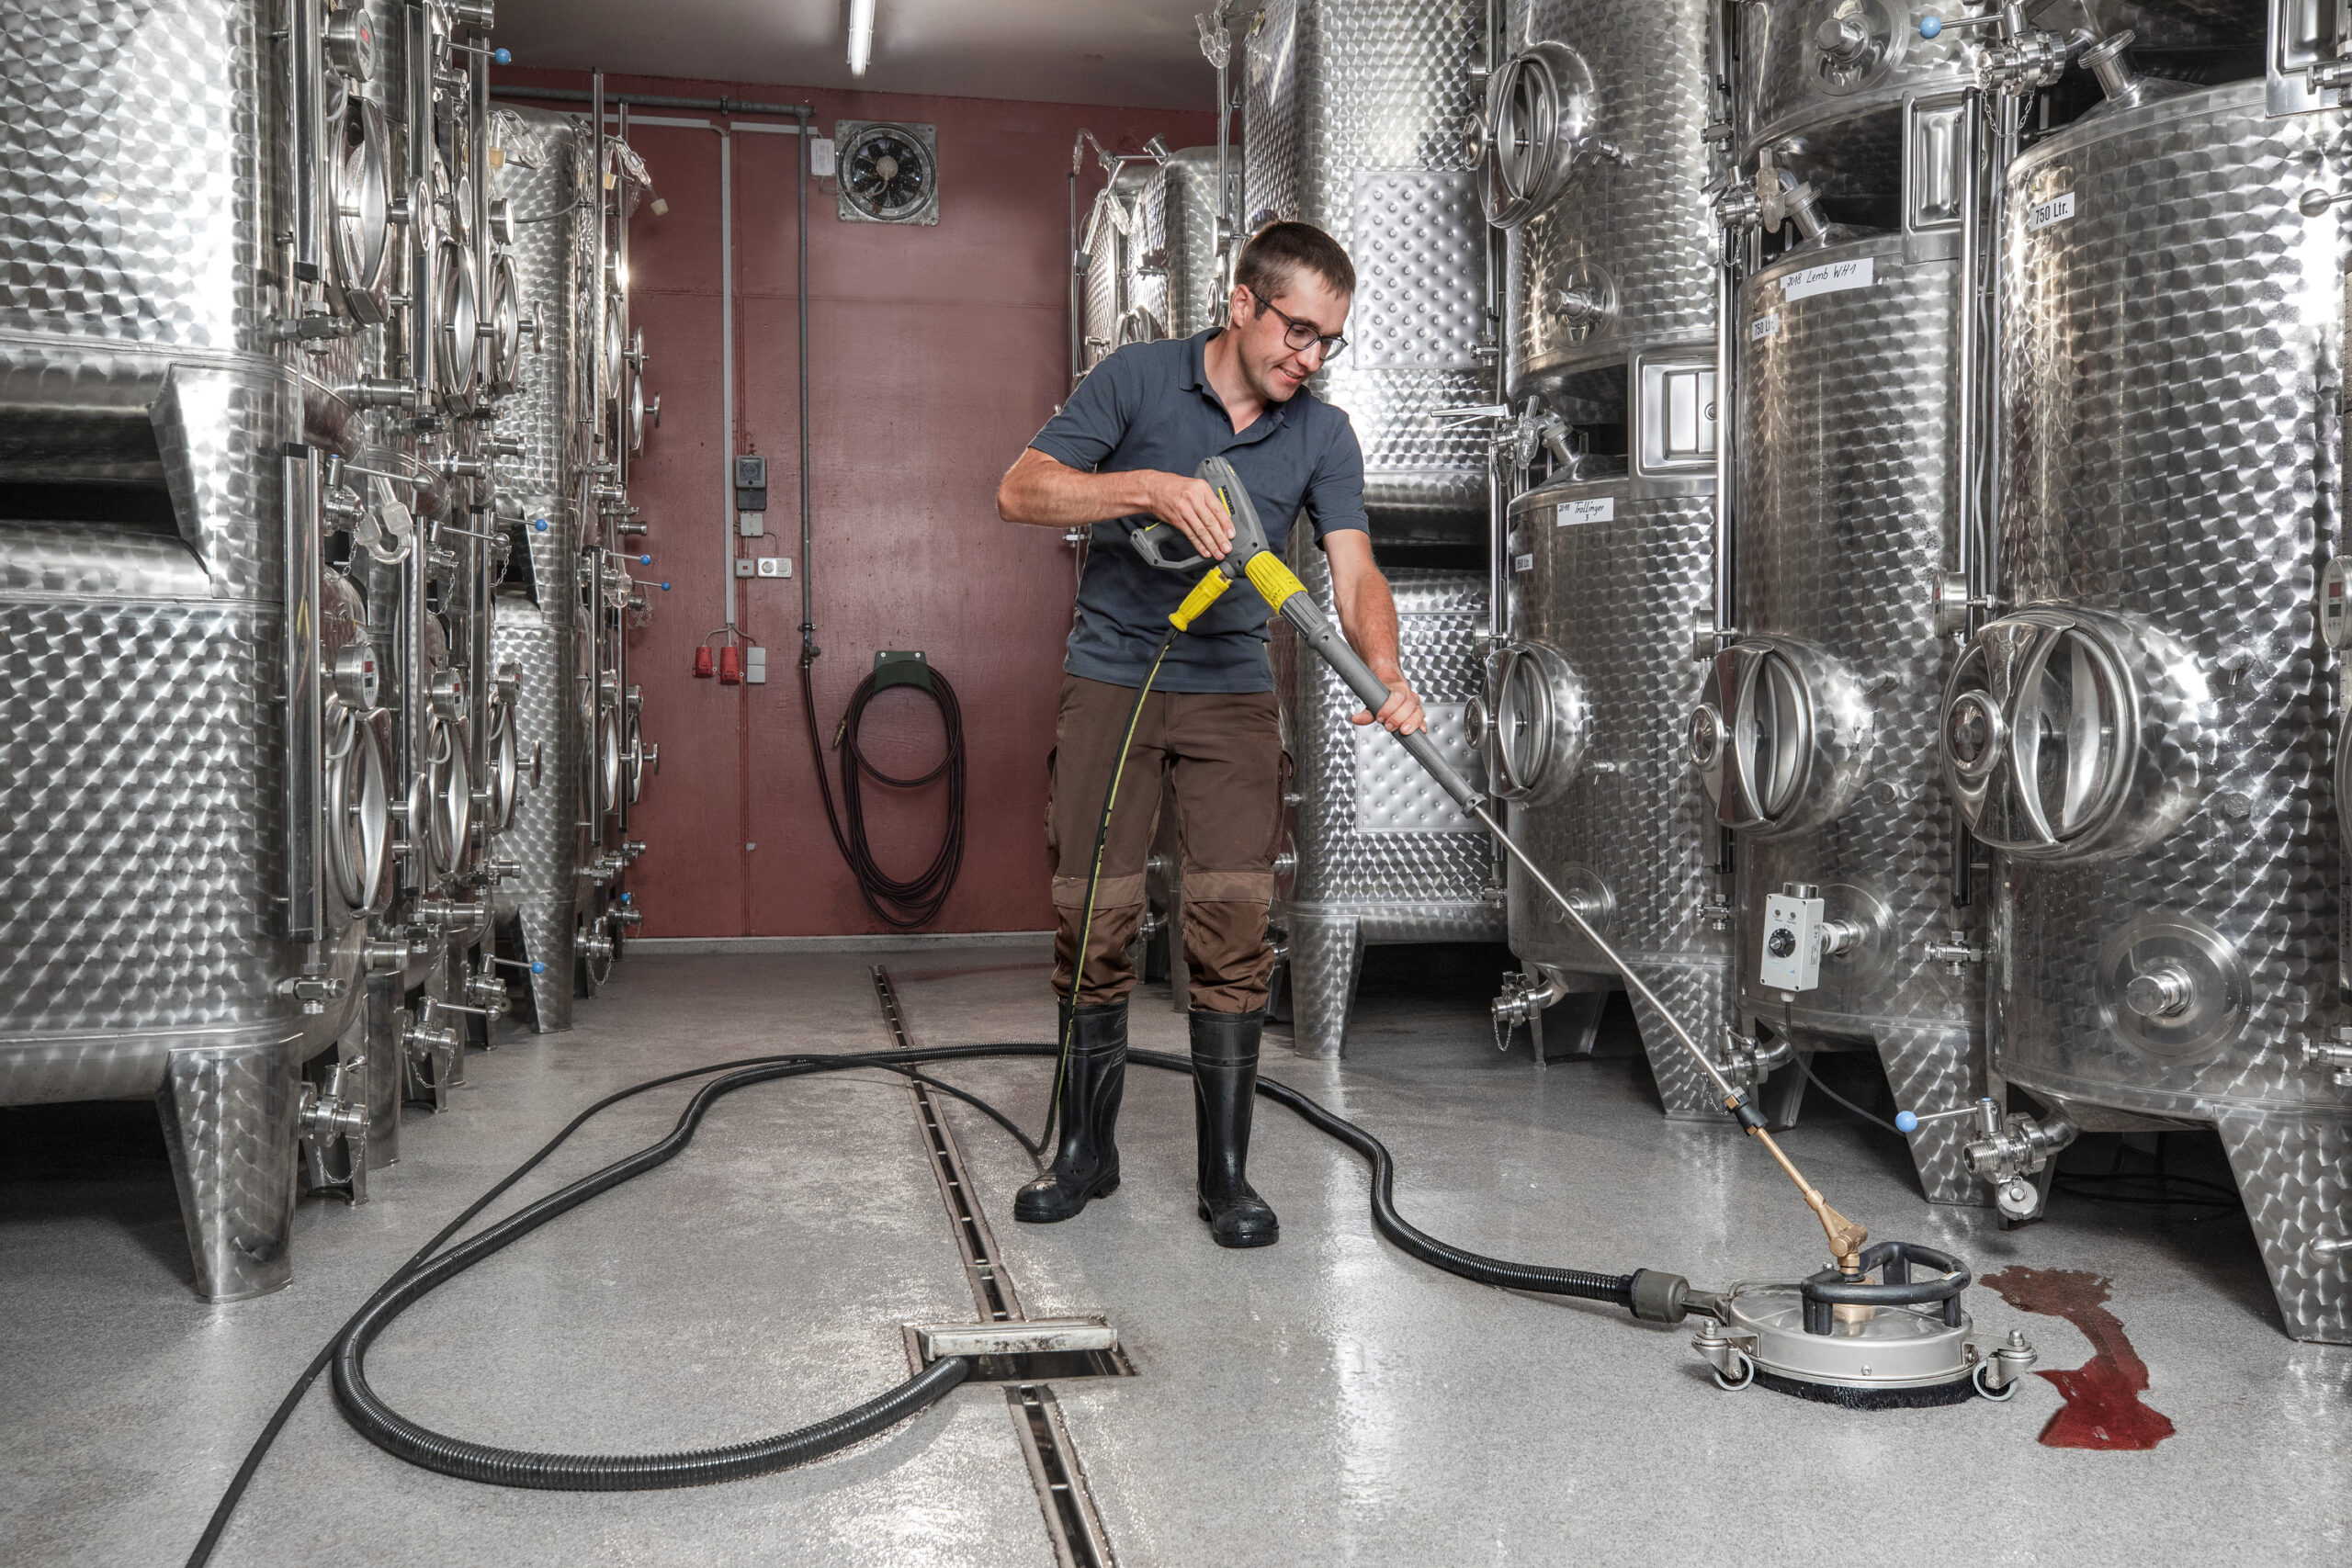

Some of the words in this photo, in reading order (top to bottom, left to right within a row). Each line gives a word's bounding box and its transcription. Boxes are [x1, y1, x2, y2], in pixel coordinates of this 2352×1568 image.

[2035, 205, 2051, 224] 750
[2053, 202, 2068, 218] Ltr.
[1786, 272, 1803, 288] 2018
[1806, 266, 1829, 284] Lemb
[1755, 321, 1764, 336] 750
[1574, 501, 1605, 515] Trollinger
[1584, 513, 1589, 522] 3
